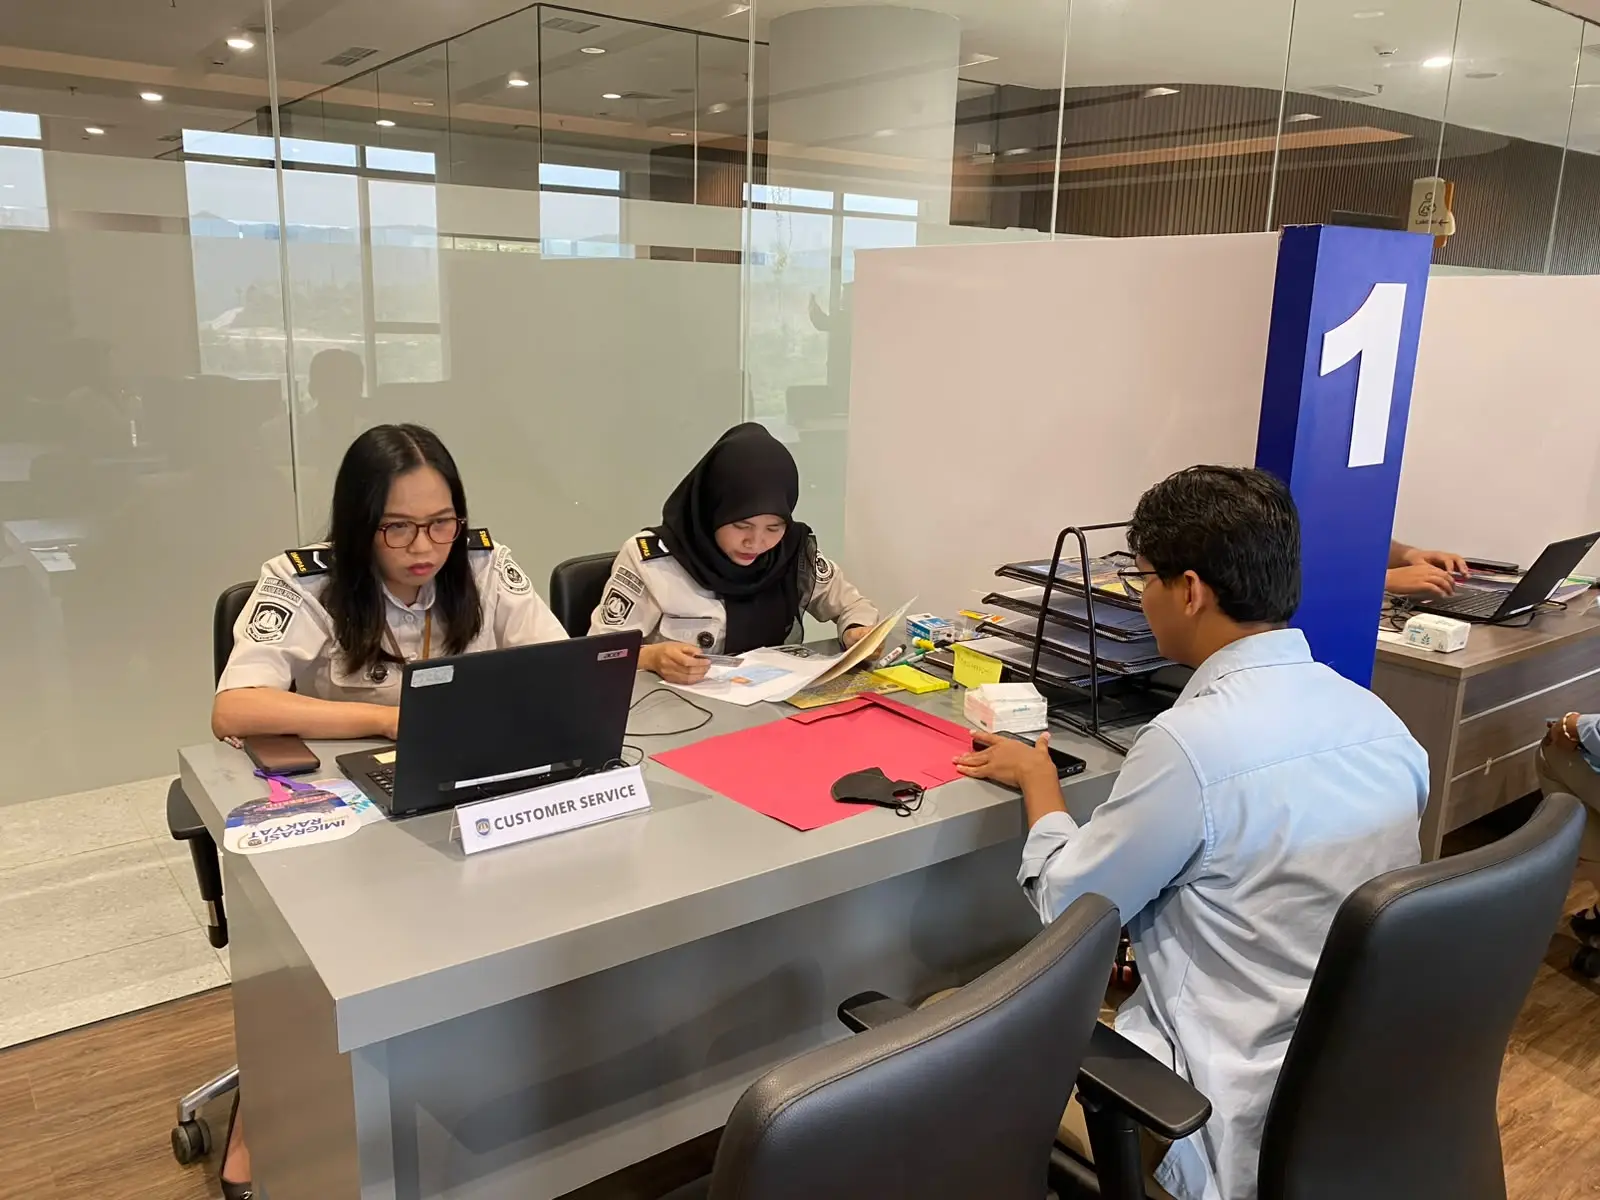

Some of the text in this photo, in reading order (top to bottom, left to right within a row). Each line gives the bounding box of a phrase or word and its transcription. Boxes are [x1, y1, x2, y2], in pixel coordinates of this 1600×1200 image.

[1319, 283, 1407, 468] 1
[494, 784, 636, 830] CUSTOMER SERVICE
[248, 817, 321, 840] RAKYAT
[265, 819, 345, 843] IMIGRASI
